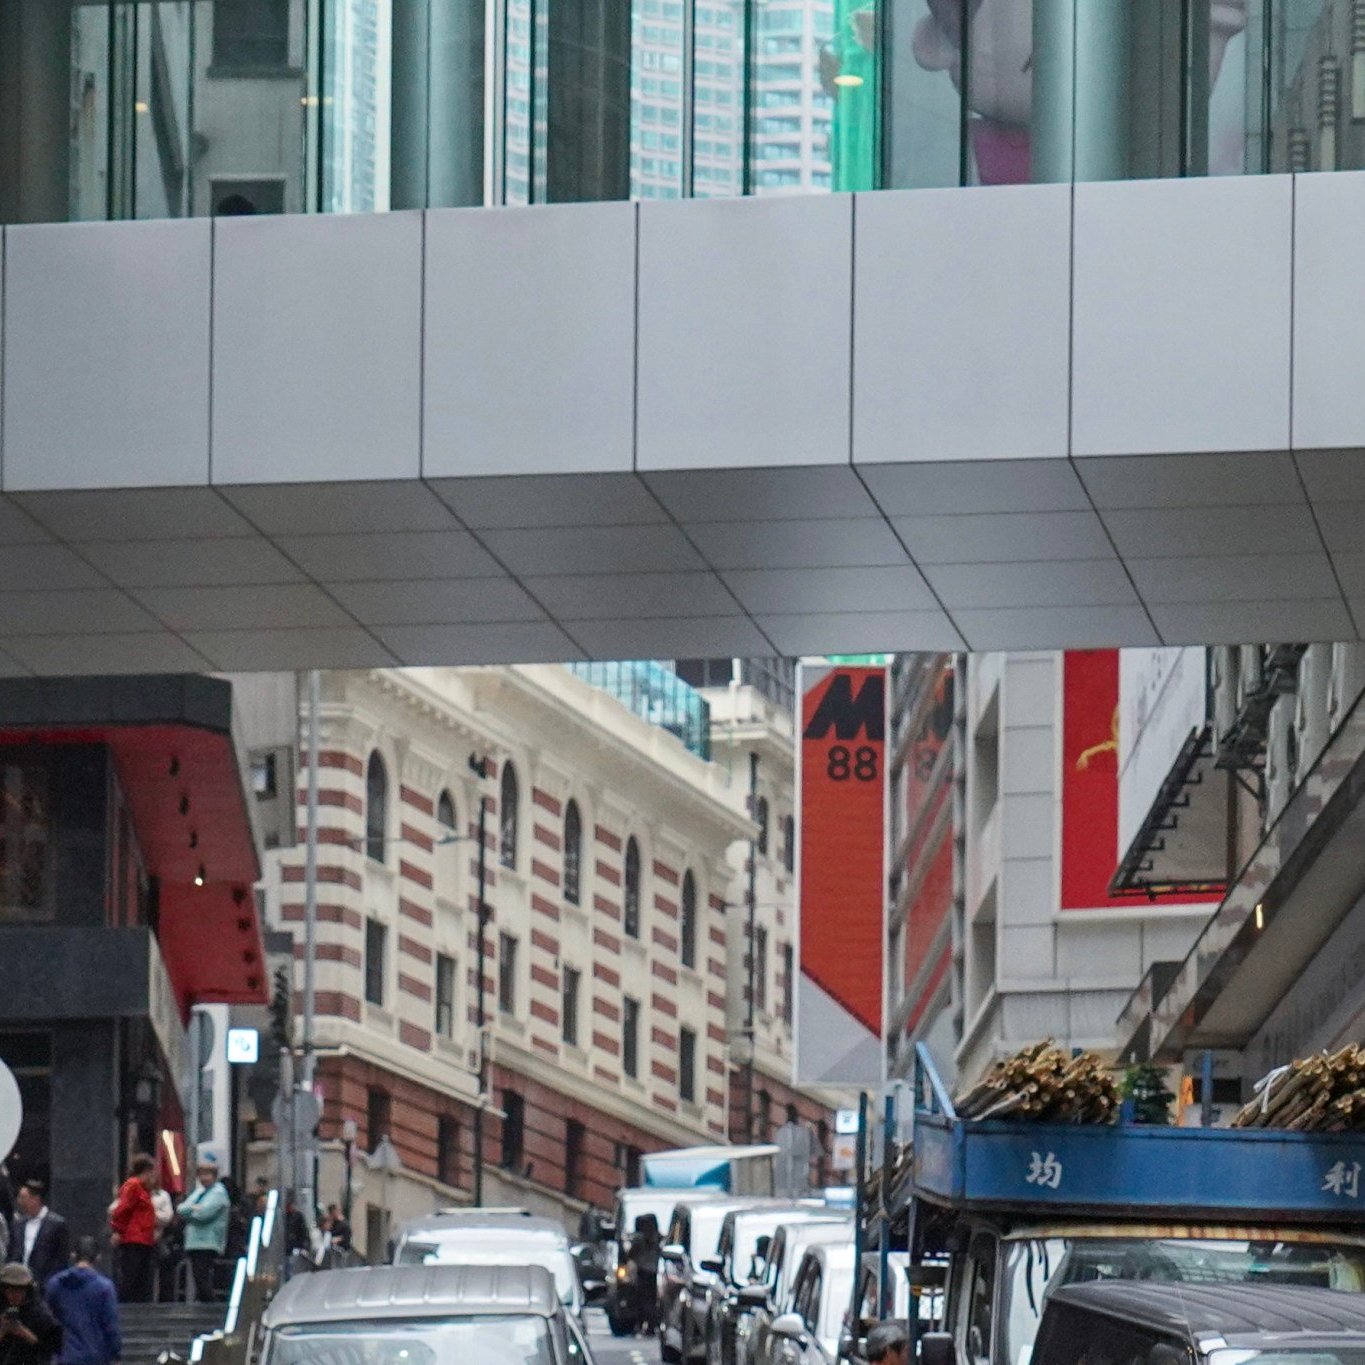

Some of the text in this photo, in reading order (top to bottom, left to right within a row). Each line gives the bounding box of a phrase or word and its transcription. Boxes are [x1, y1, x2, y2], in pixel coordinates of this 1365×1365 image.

[827, 745, 878, 782] 88
[1025, 1152, 1362, 1198] 均 利
